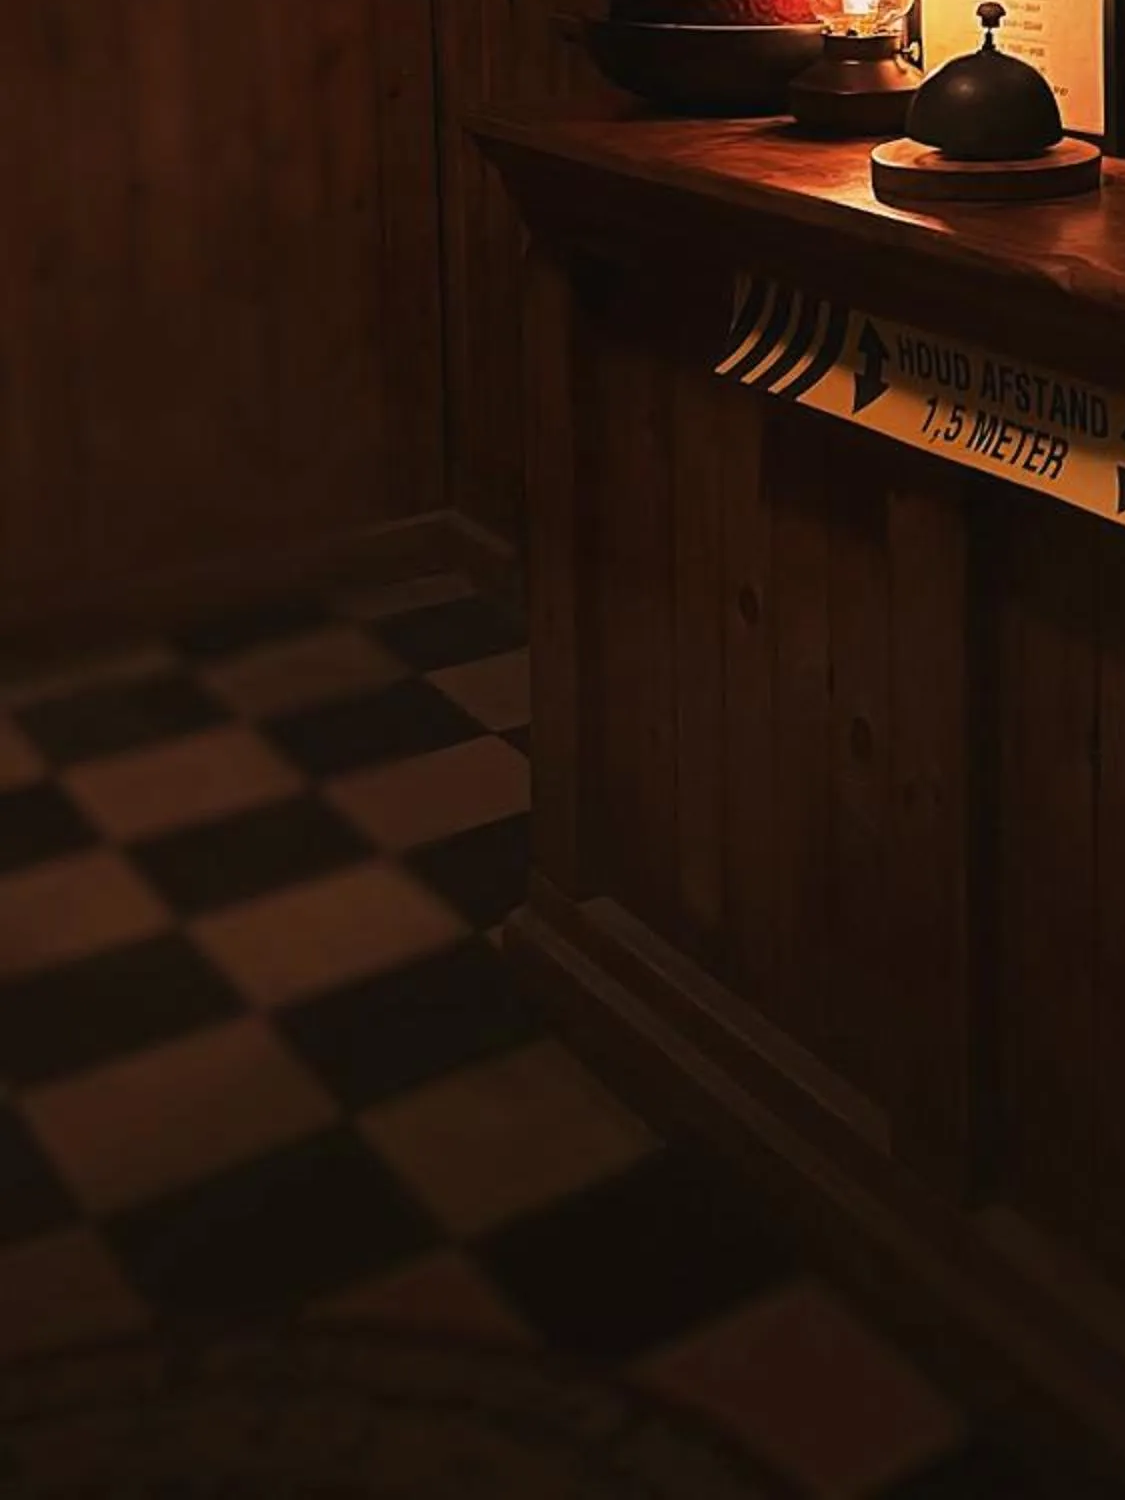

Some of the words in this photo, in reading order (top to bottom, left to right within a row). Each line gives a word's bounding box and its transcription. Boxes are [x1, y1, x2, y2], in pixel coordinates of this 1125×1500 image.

[896, 334, 972, 391] HOUD
[981, 359, 1109, 438] AFSTAND
[920, 393, 967, 444] 1,5
[966, 409, 1069, 481] METER
